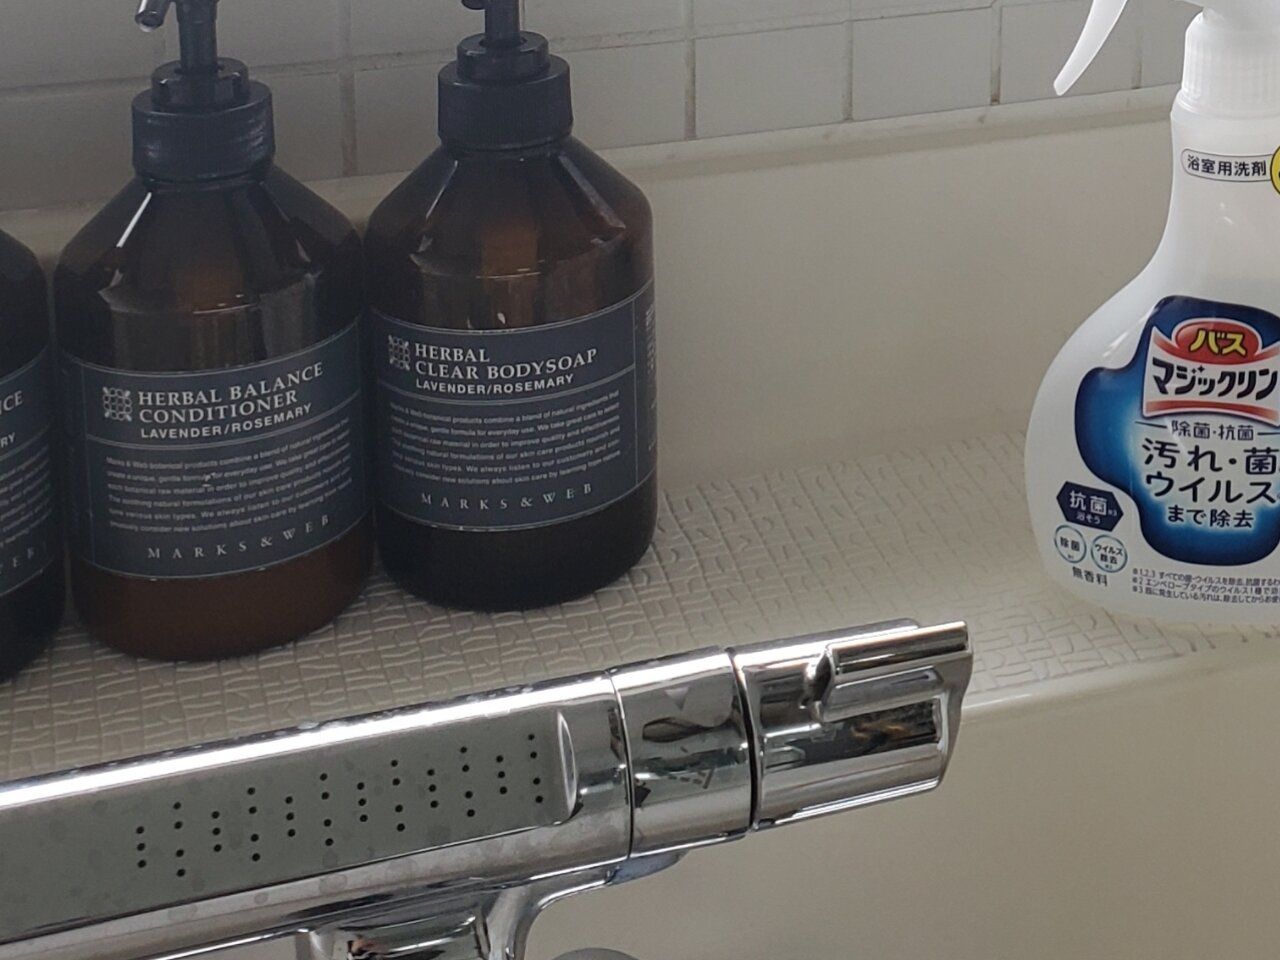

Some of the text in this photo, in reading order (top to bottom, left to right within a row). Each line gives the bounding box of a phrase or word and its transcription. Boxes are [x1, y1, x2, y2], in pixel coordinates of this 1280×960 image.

[1187, 153, 1267, 177] 浴室用洗剤
[414, 342, 490, 364] HERBAL
[1188, 328, 1248, 358] バス
[415, 347, 599, 381] CLEAR BODYSOAP
[1151, 356, 1279, 401] マジックリン
[138, 361, 324, 407] HERBAL BALANCE
[415, 373, 575, 395] LAVENDER/ROSEMARY
[0, 390, 23, 414] CE
[138, 390, 298, 424] CONDITIONER
[141, 402, 313, 438] LAVENDER/ROSEMARY
[421, 491, 509, 510] MARKS
[542, 482, 593, 505] WEB
[1145, 471, 1277, 504] ウイルス
[1167, 505, 1254, 528] まで除去
[147, 540, 248, 559] MARKS
[282, 514, 330, 541] WEB
